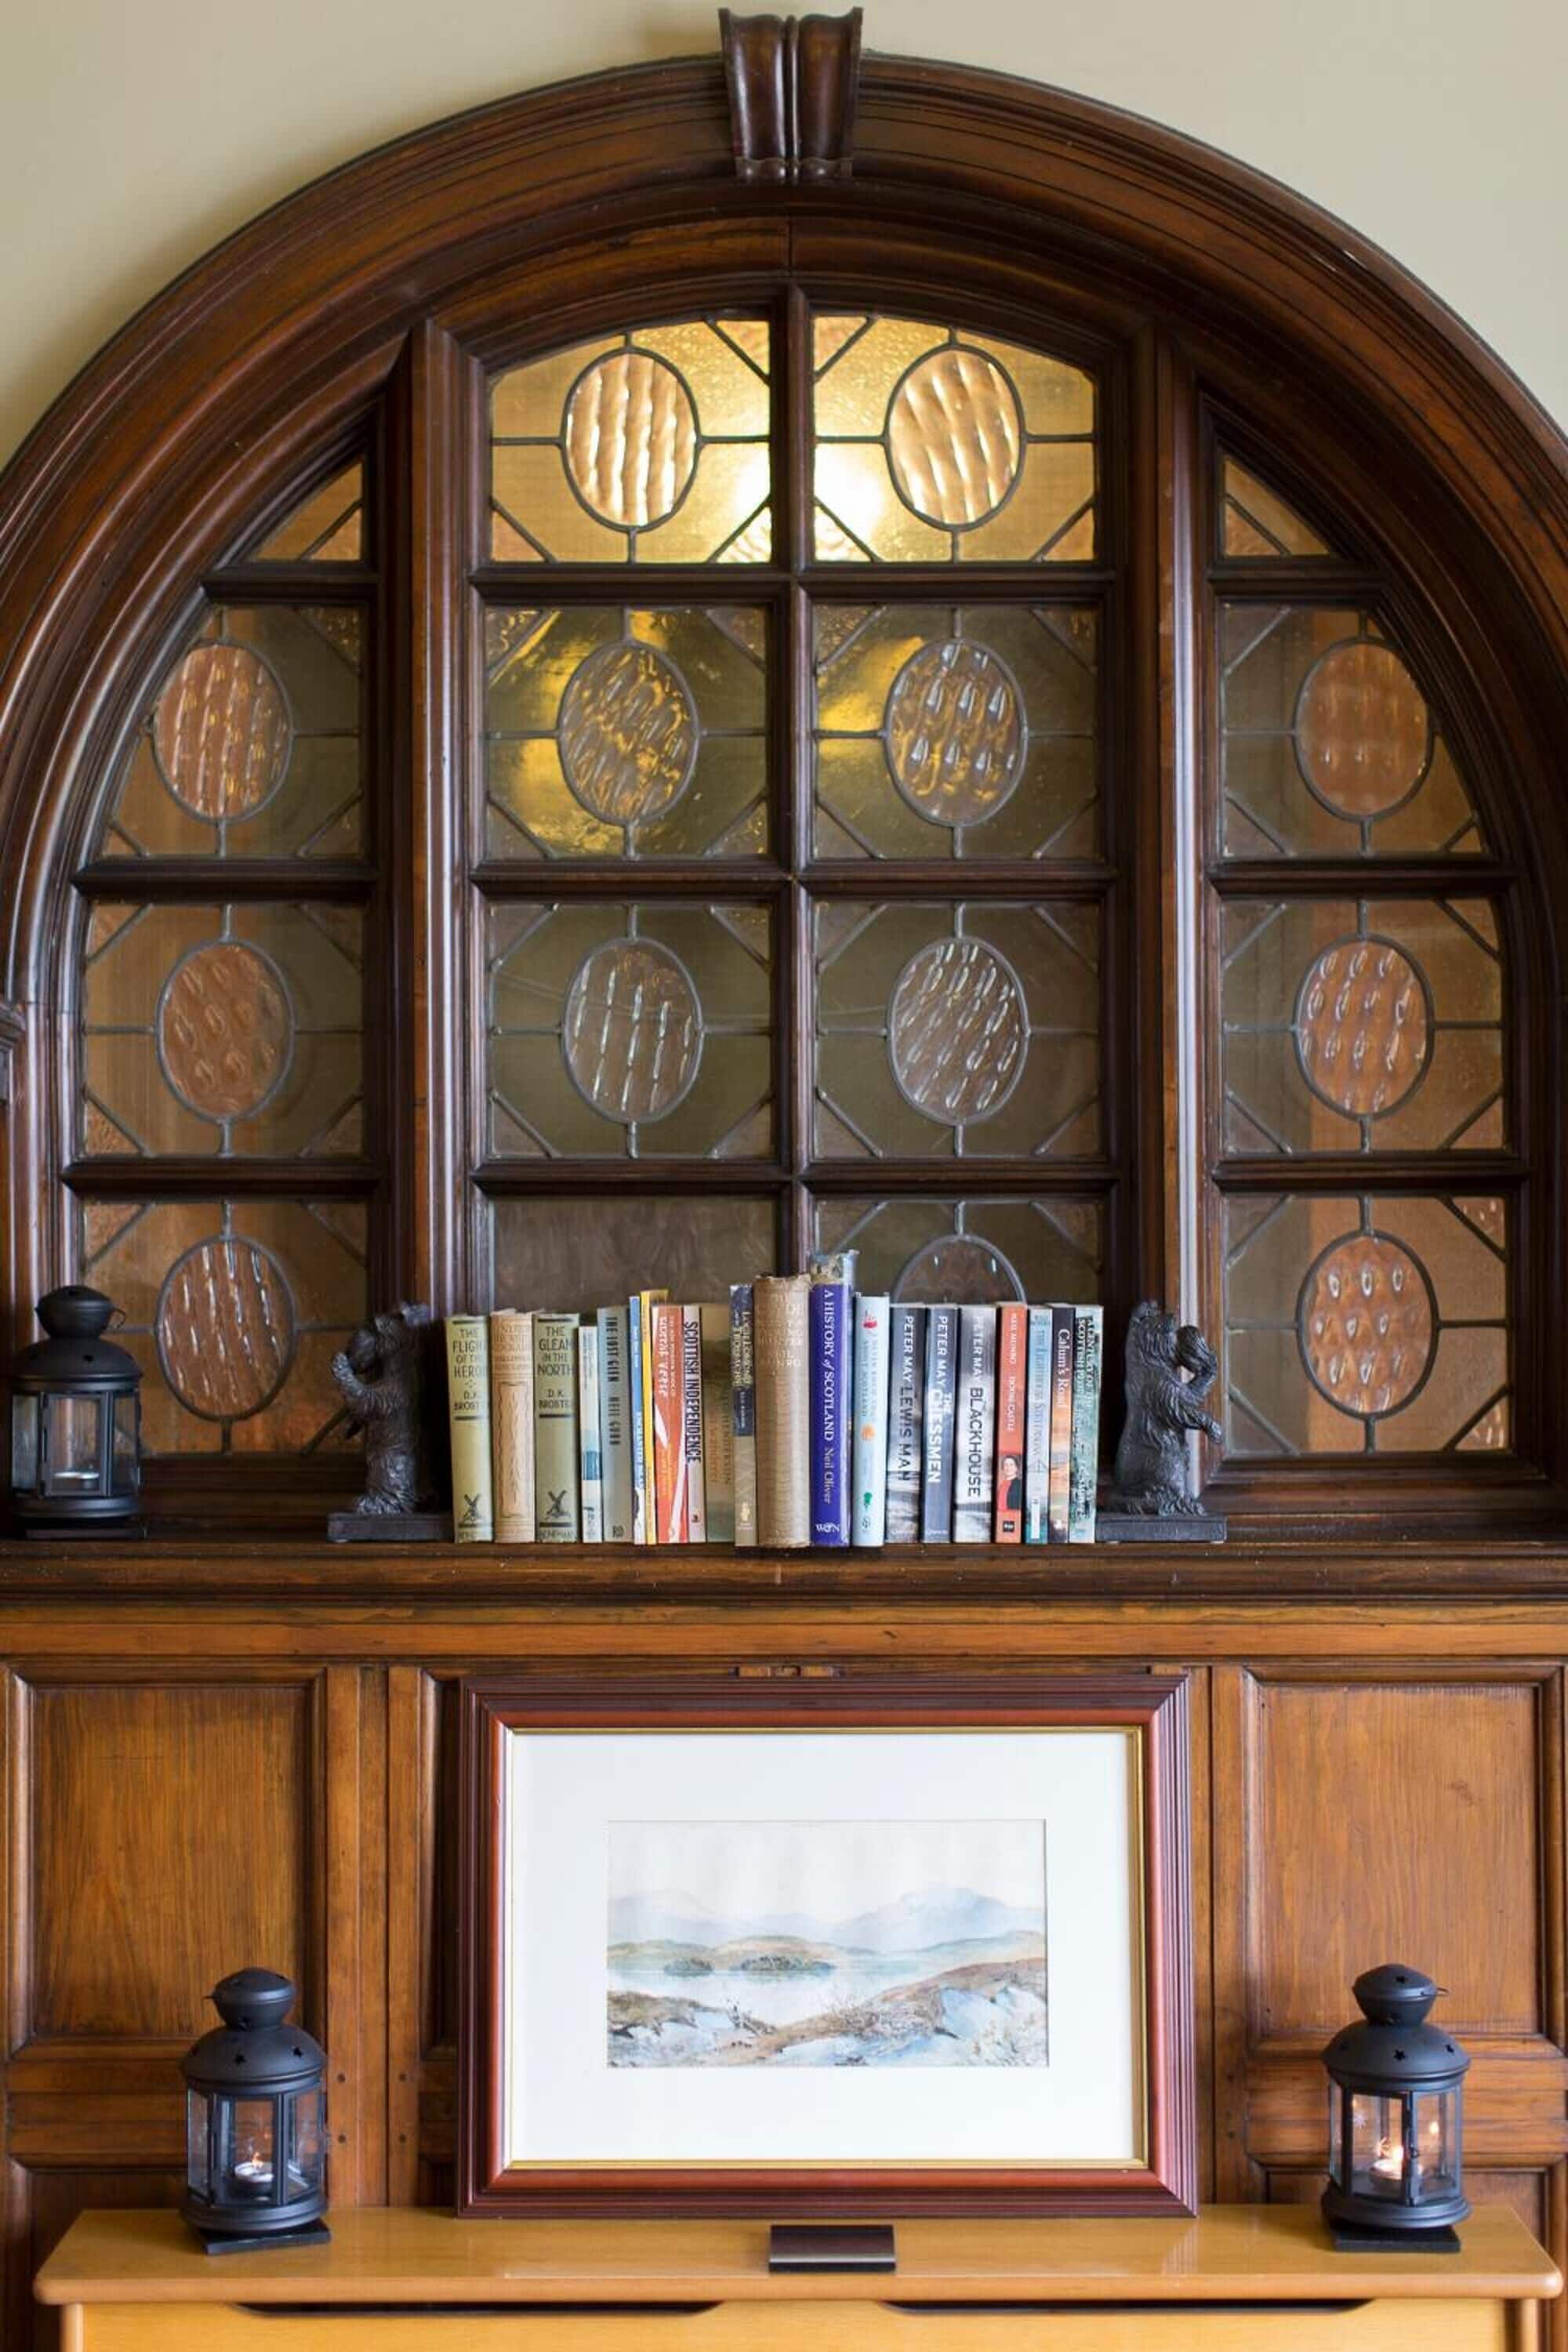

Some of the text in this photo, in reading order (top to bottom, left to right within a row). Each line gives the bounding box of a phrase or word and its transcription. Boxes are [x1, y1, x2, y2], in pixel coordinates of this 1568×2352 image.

[452, 1341, 488, 1353] FLIGH
[546, 1327, 565, 1336] THE
[552, 1353, 568, 1362] THE
[606, 1316, 619, 1382] THE LOST GLEN
[902, 1316, 913, 1383] PETER MAY
[935, 1316, 948, 1387] PETER MAY
[971, 1316, 983, 1380] PETER MAY
[1056, 1328, 1071, 1376] Calum's
[1076, 1318, 1086, 1368] SCOTTISH
[538, 1364, 573, 1376] NORTH
[684, 1321, 702, 1463] SCOTTISH INDEPENDENCE
[822, 1289, 834, 1441] A HISTORY of SCOTLAND
[898, 1386, 912, 1481] LEWIS MAN
[927, 1388, 942, 1483] CHESSMEN
[967, 1387, 984, 1497] BLACKHOUSE
[823, 1446, 833, 1504] Neil Oliver
[815, 1523, 840, 1533] W&N
